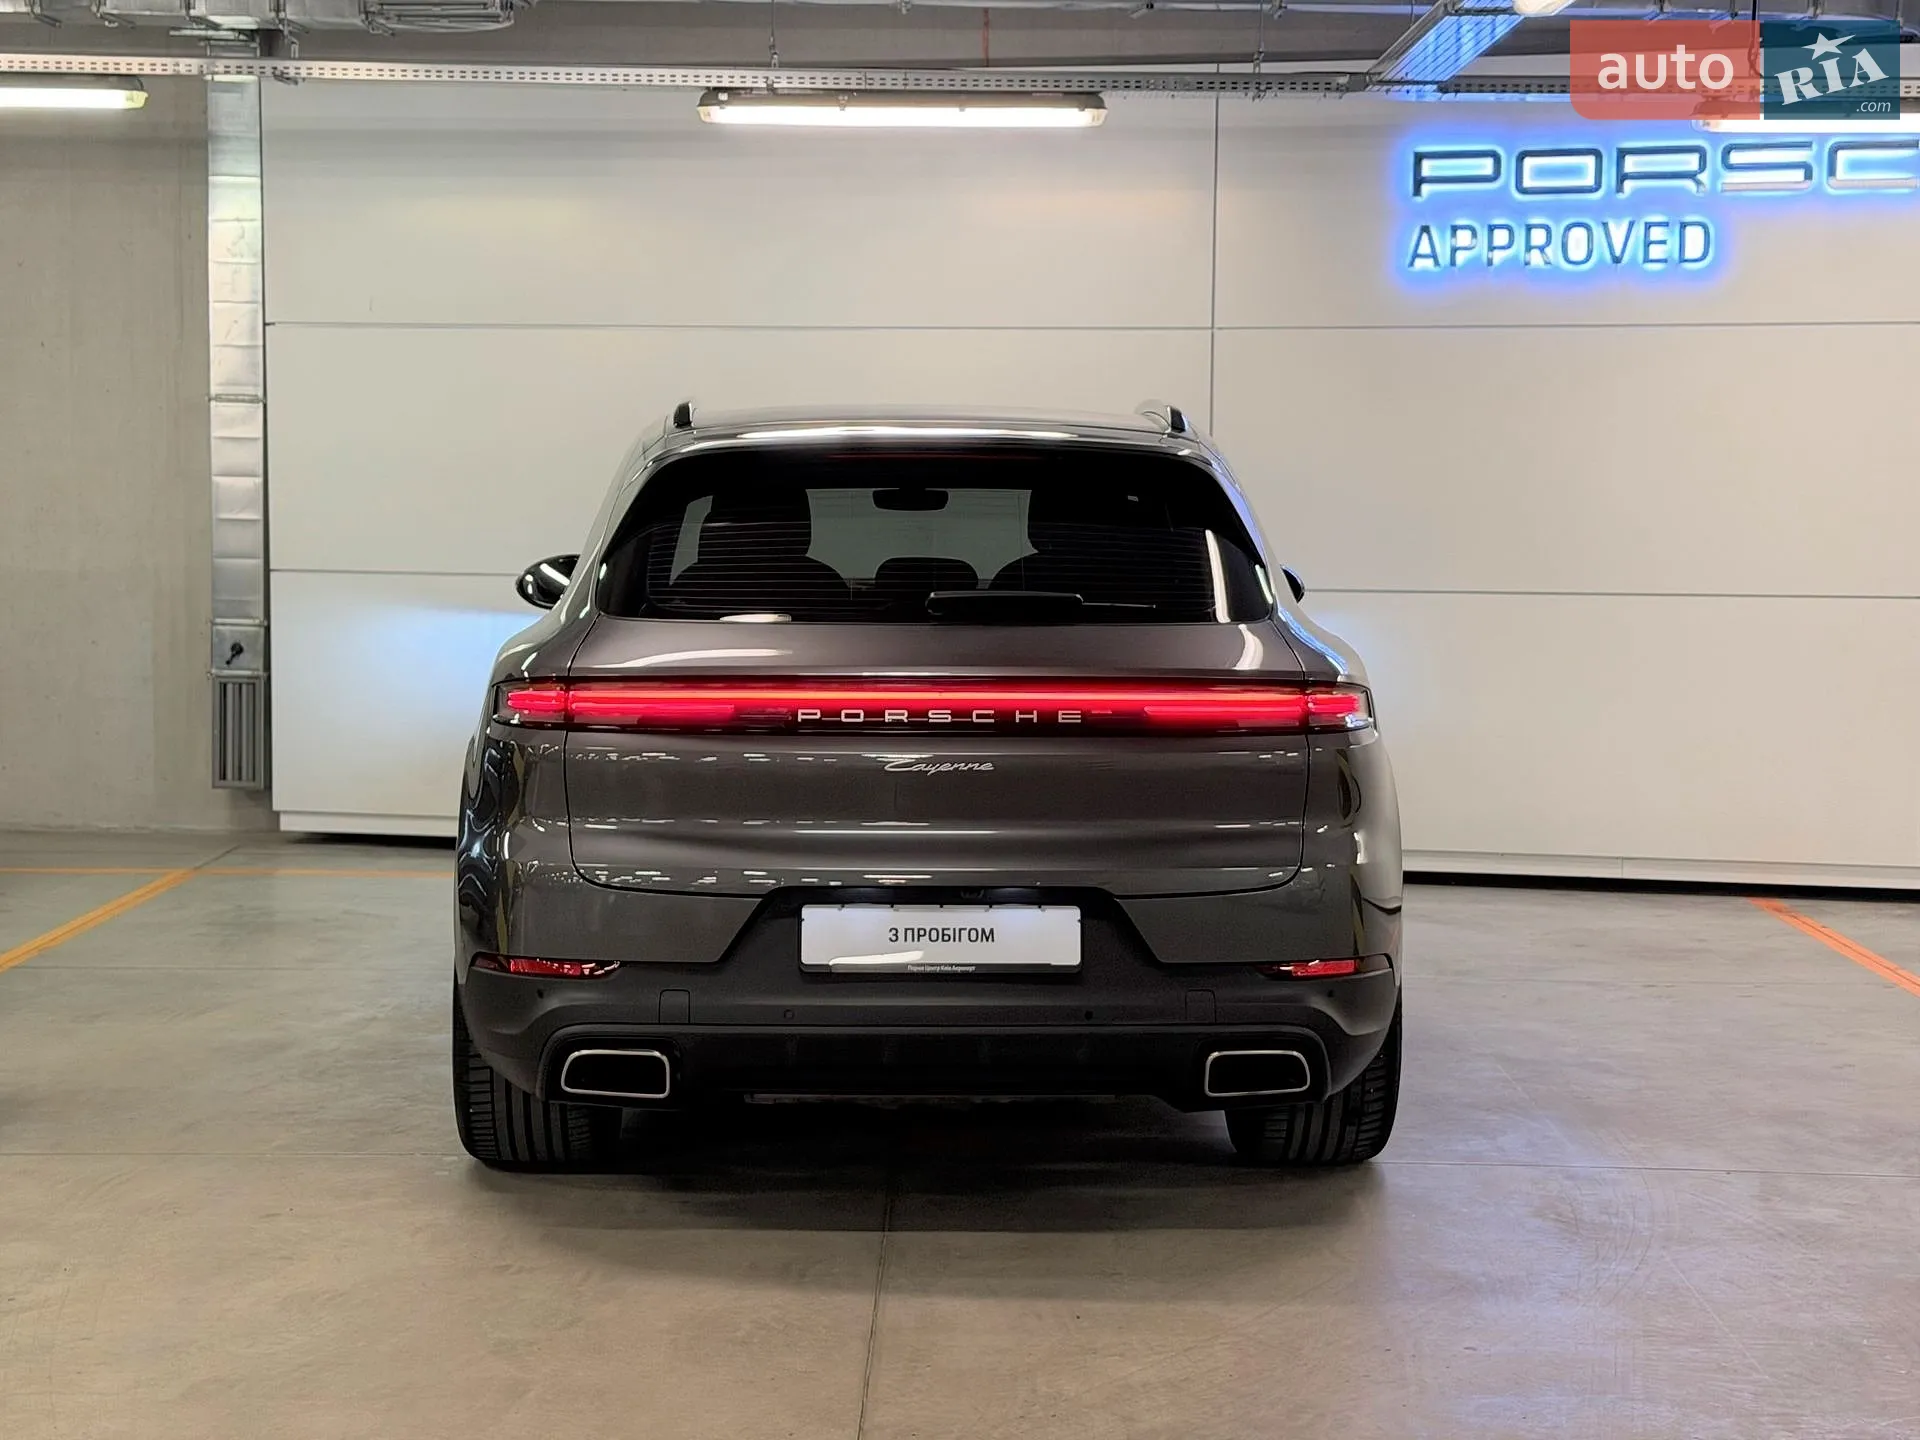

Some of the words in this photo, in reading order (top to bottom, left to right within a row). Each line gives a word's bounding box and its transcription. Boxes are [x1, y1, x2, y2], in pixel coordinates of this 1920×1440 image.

[1412, 139, 1919, 197] PORSC
[1408, 220, 1711, 268] APPROVED
[798, 709, 1082, 723] PORSCHE
[884, 759, 995, 776] Cayenne
[904, 927, 995, 943] ПРОБІГОМ
